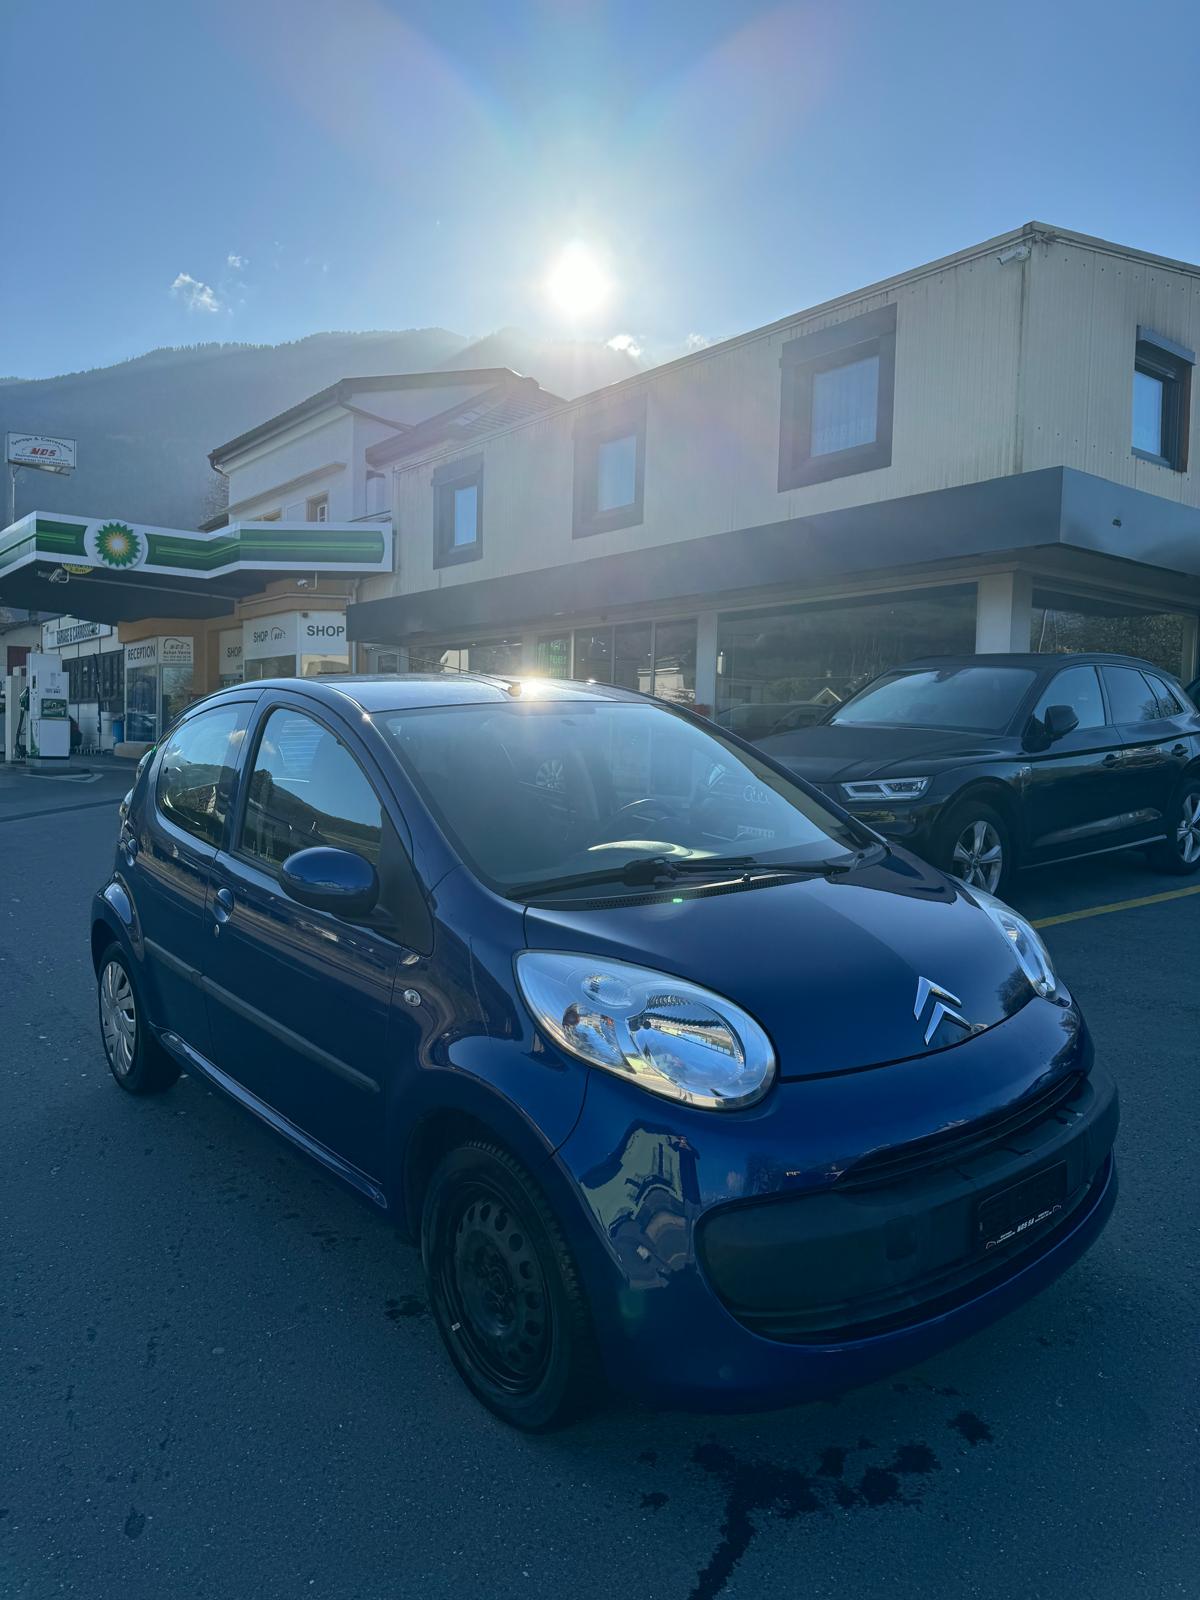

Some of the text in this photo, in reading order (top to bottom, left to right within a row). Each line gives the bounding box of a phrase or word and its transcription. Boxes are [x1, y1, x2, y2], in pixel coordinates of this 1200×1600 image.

[253, 630, 269, 643] SHOP
[307, 625, 345, 637] SHOP
[127, 645, 156, 661] RECEPTION
[226, 646, 242, 658] SHOP
